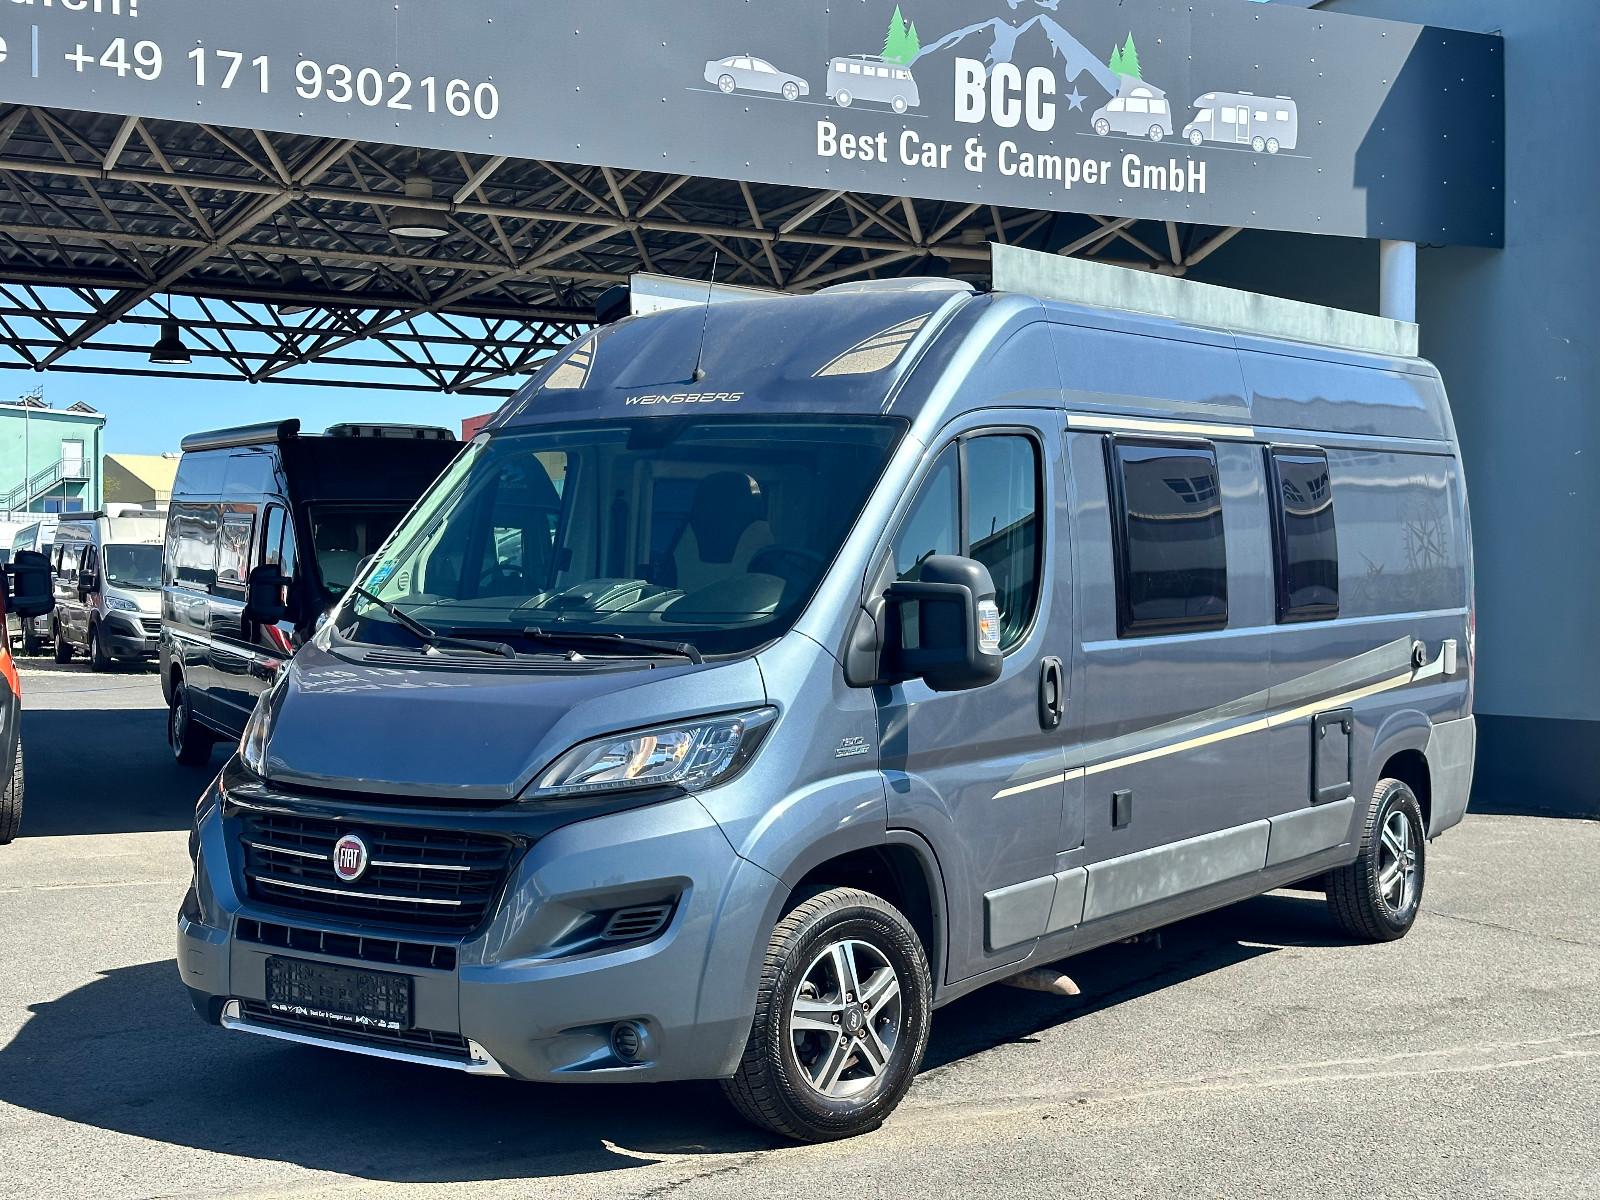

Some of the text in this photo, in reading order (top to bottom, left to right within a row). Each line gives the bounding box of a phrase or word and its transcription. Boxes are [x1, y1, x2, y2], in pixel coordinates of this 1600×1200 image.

[64, 37, 500, 120] +49 171 9302160
[954, 57, 1057, 132] BCC
[816, 120, 1206, 194] Best Car & Camper GmbH
[625, 392, 745, 406] WEINSBERG
[340, 847, 360, 869] FIAT
